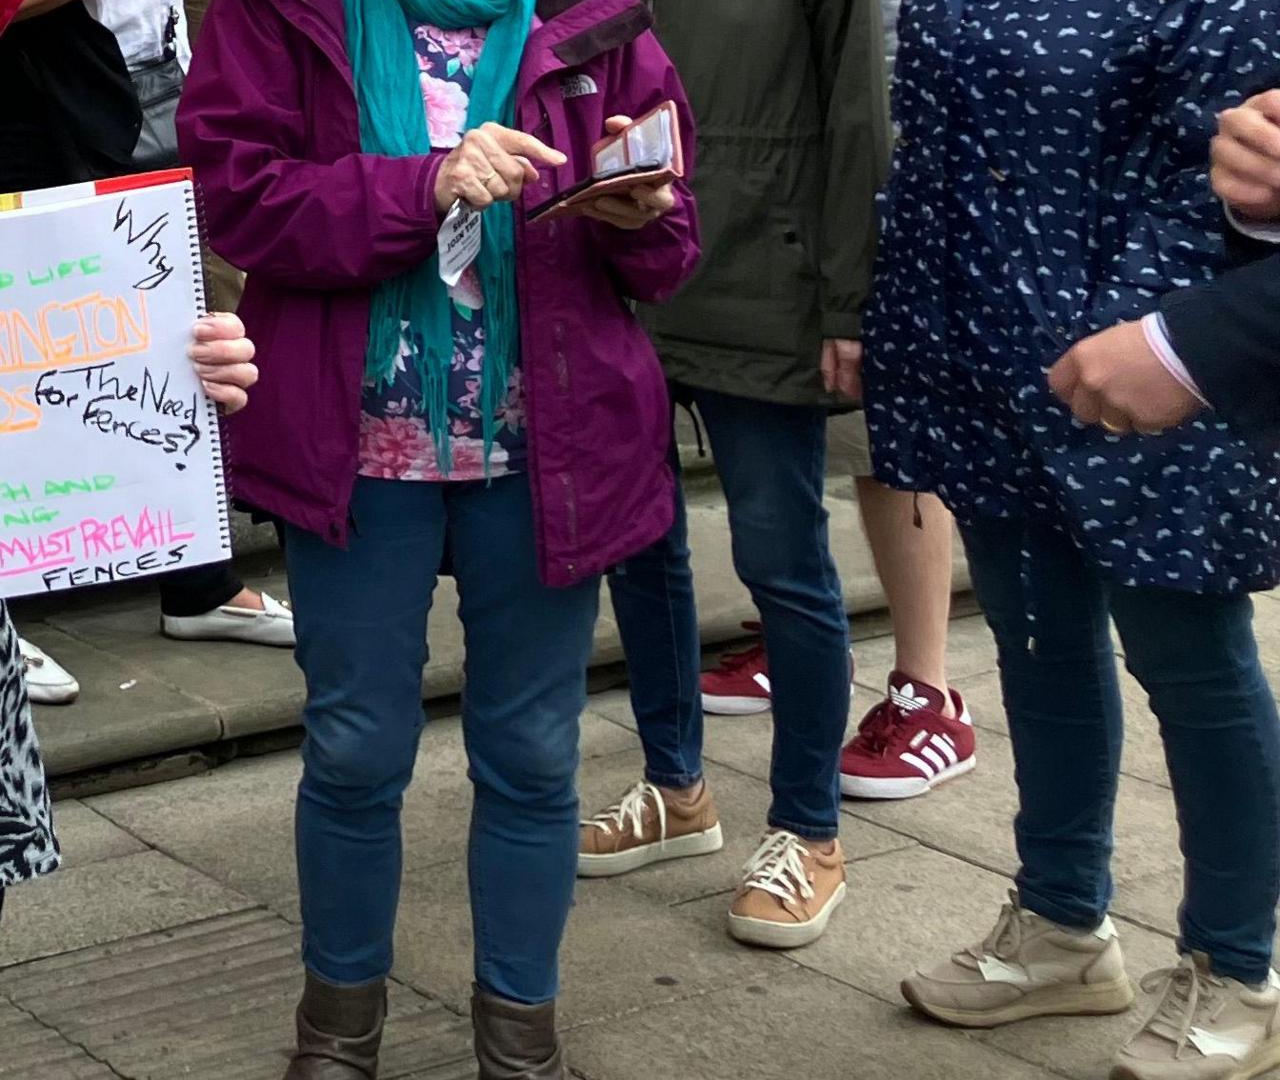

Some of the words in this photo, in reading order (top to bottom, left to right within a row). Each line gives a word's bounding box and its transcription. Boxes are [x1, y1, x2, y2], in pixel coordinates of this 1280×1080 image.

[27, 254, 103, 287] LIFE
[34, 369, 79, 409] For
[59, 361, 139, 402] The
[140, 366, 198, 426] Need
[44, 475, 116, 497] AND
[78, 504, 196, 560] PREVAIL
[41, 543, 189, 591] FENCES
